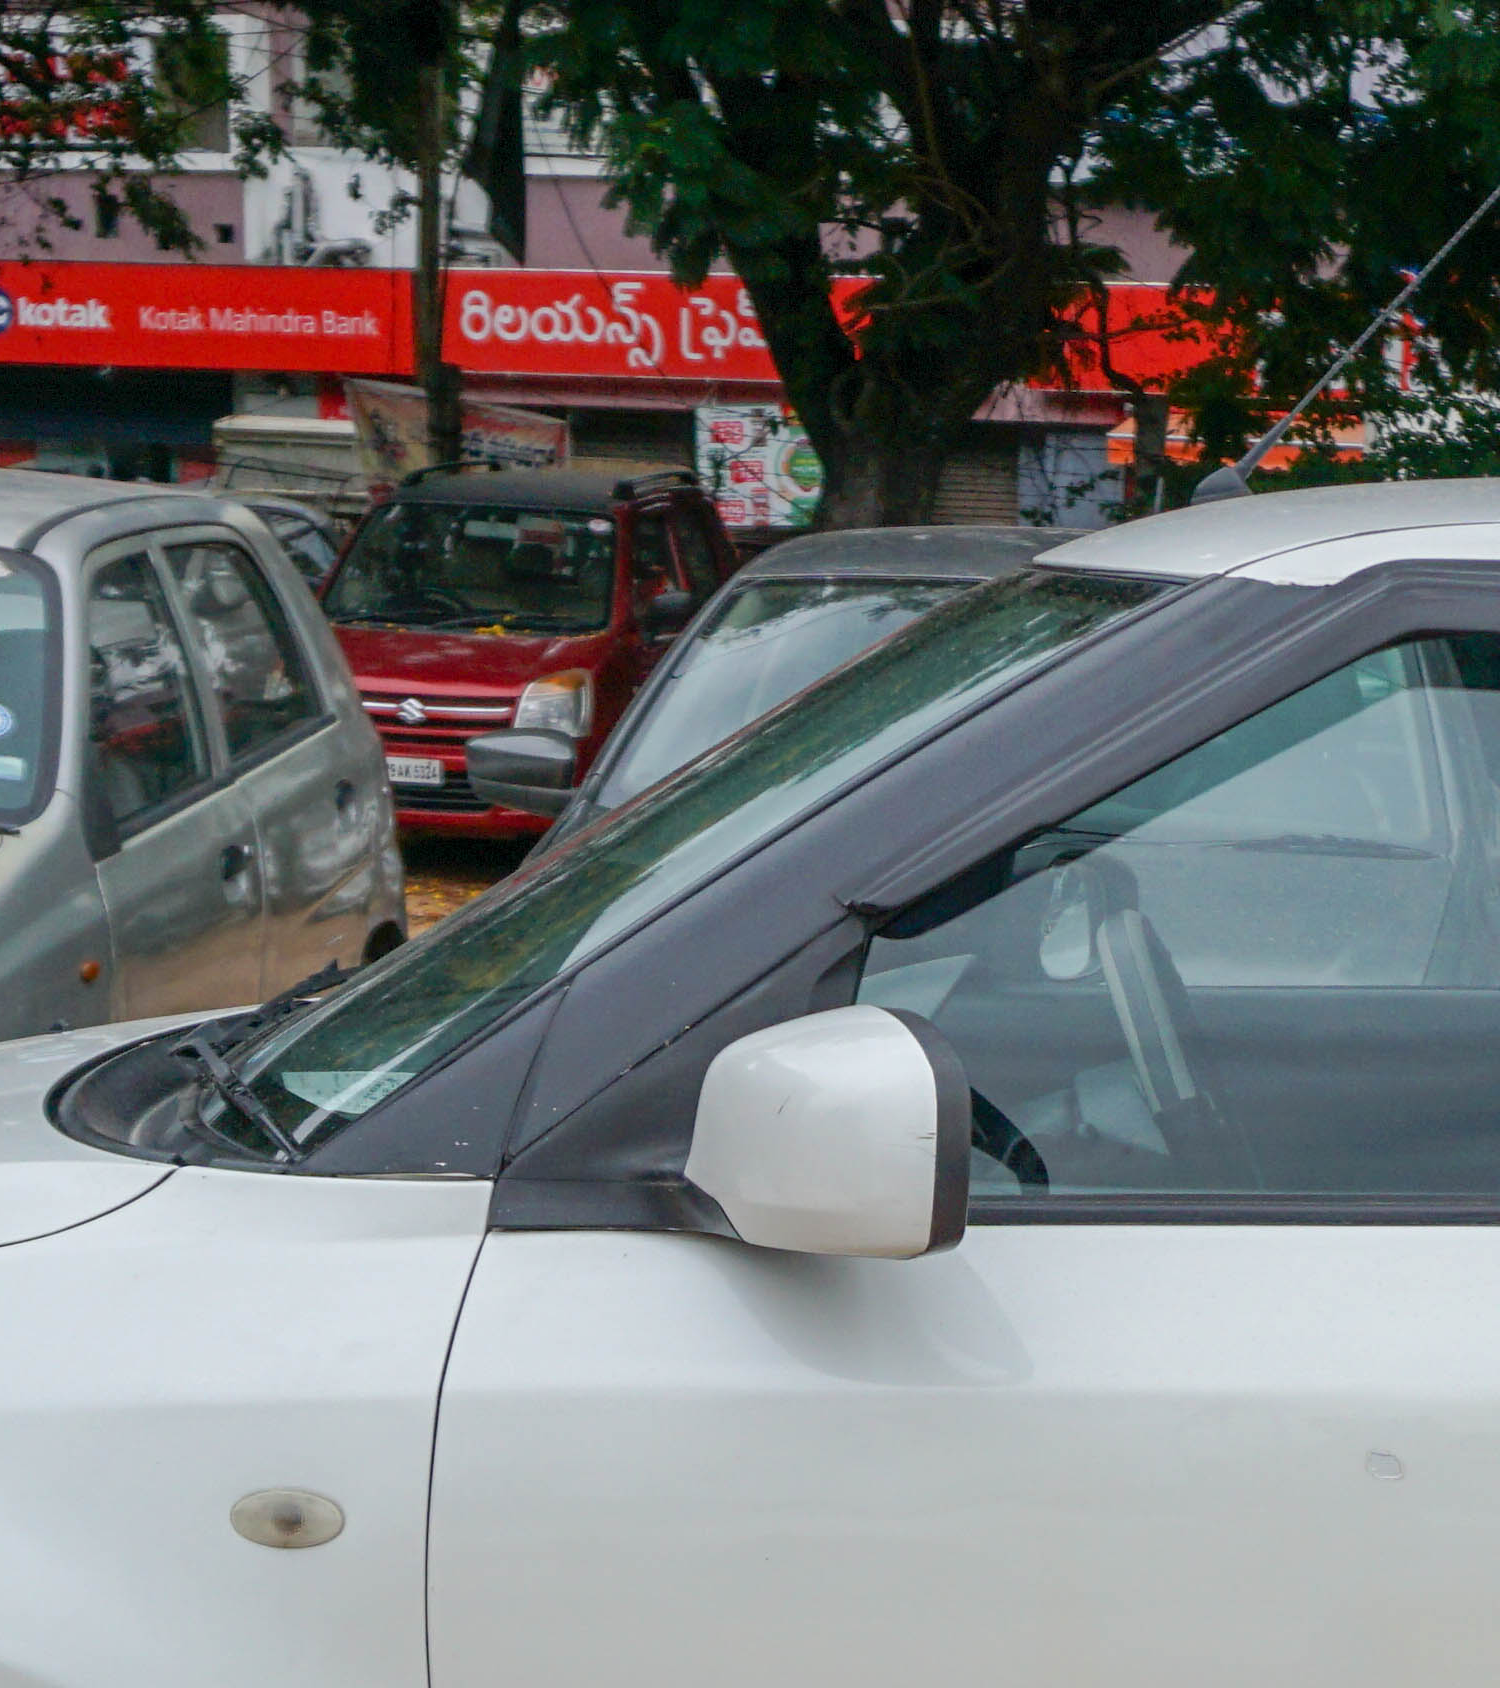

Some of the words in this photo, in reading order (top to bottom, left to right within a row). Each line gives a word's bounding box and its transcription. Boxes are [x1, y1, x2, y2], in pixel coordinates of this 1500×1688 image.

[18, 297, 109, 329] kotak
[140, 305, 201, 331] Kotak
[209, 307, 316, 335] Mahindra
[321, 310, 379, 336] Bank
